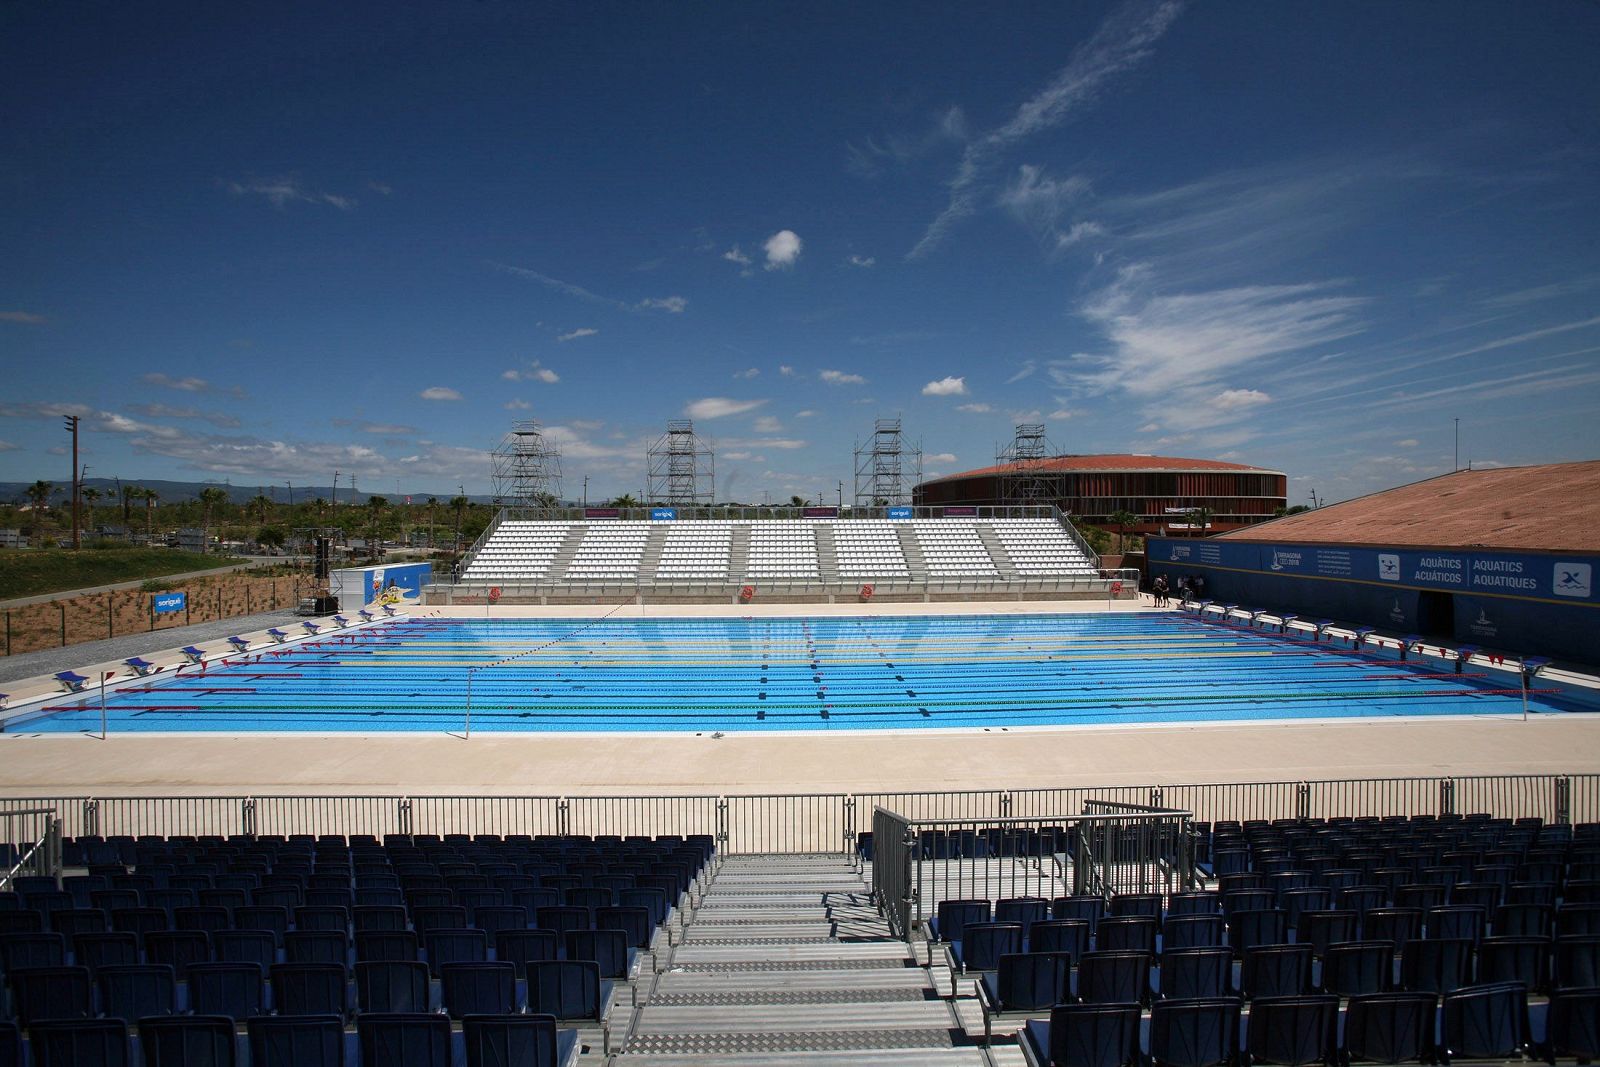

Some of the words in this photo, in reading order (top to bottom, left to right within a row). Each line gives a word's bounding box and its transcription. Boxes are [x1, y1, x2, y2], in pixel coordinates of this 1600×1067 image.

[1420, 556, 1462, 569] AQUÀTICS
[1473, 560, 1523, 573] AQUATICS
[1414, 570, 1462, 583] ACUÁTICOS
[1473, 574, 1537, 589] AQUATIQUES
